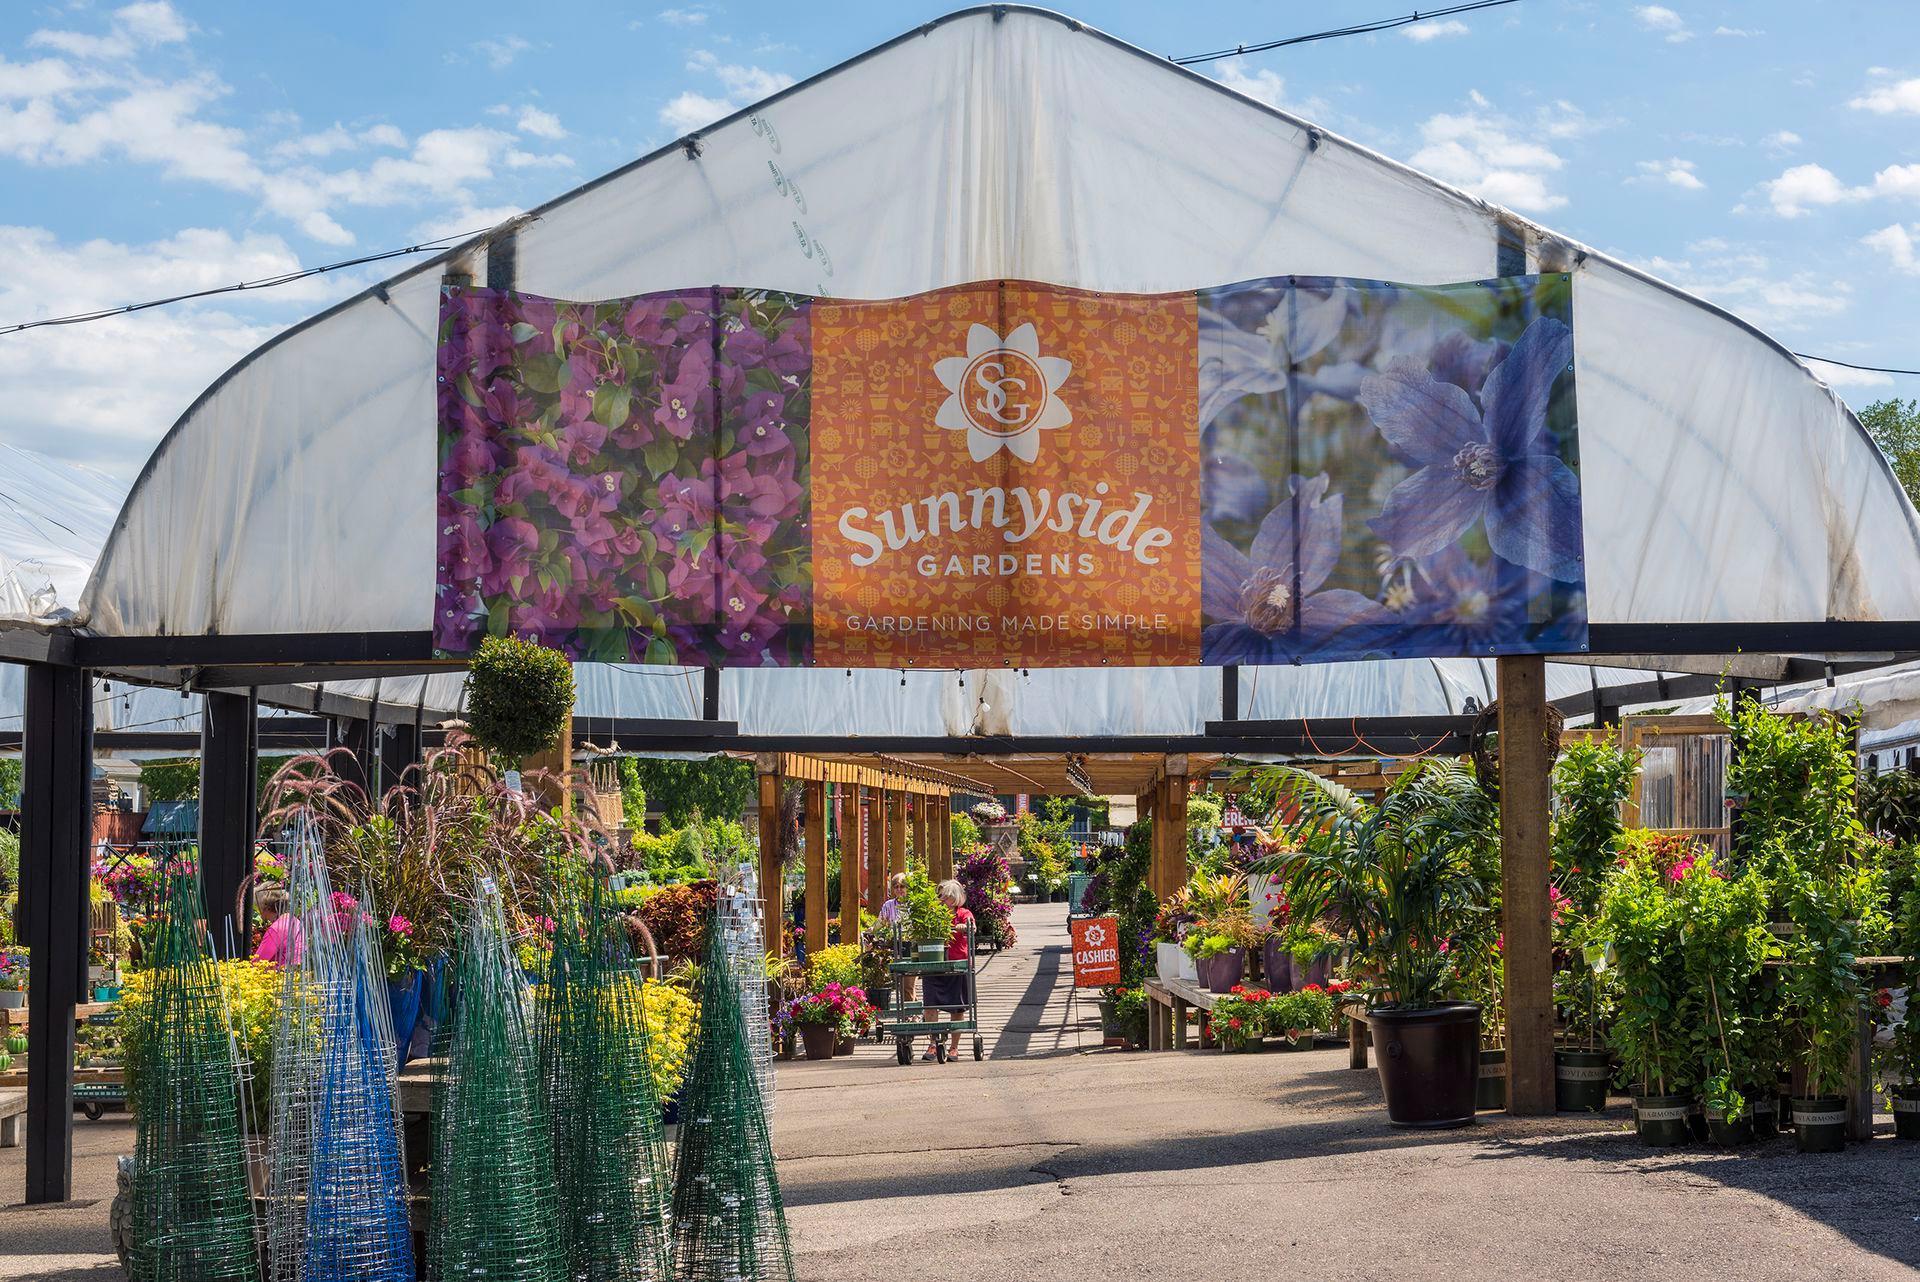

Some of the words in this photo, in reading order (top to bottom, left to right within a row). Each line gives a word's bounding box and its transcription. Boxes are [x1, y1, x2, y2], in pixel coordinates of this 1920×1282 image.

[975, 362, 1030, 424] SG
[838, 482, 1173, 567] Sunnyside
[917, 553, 1095, 577] GARDENS
[846, 615, 991, 631] GARDENING
[1002, 615, 1070, 631] MADE
[1081, 614, 1168, 631] SIMPLE
[1076, 948, 1117, 964] CASHIER
